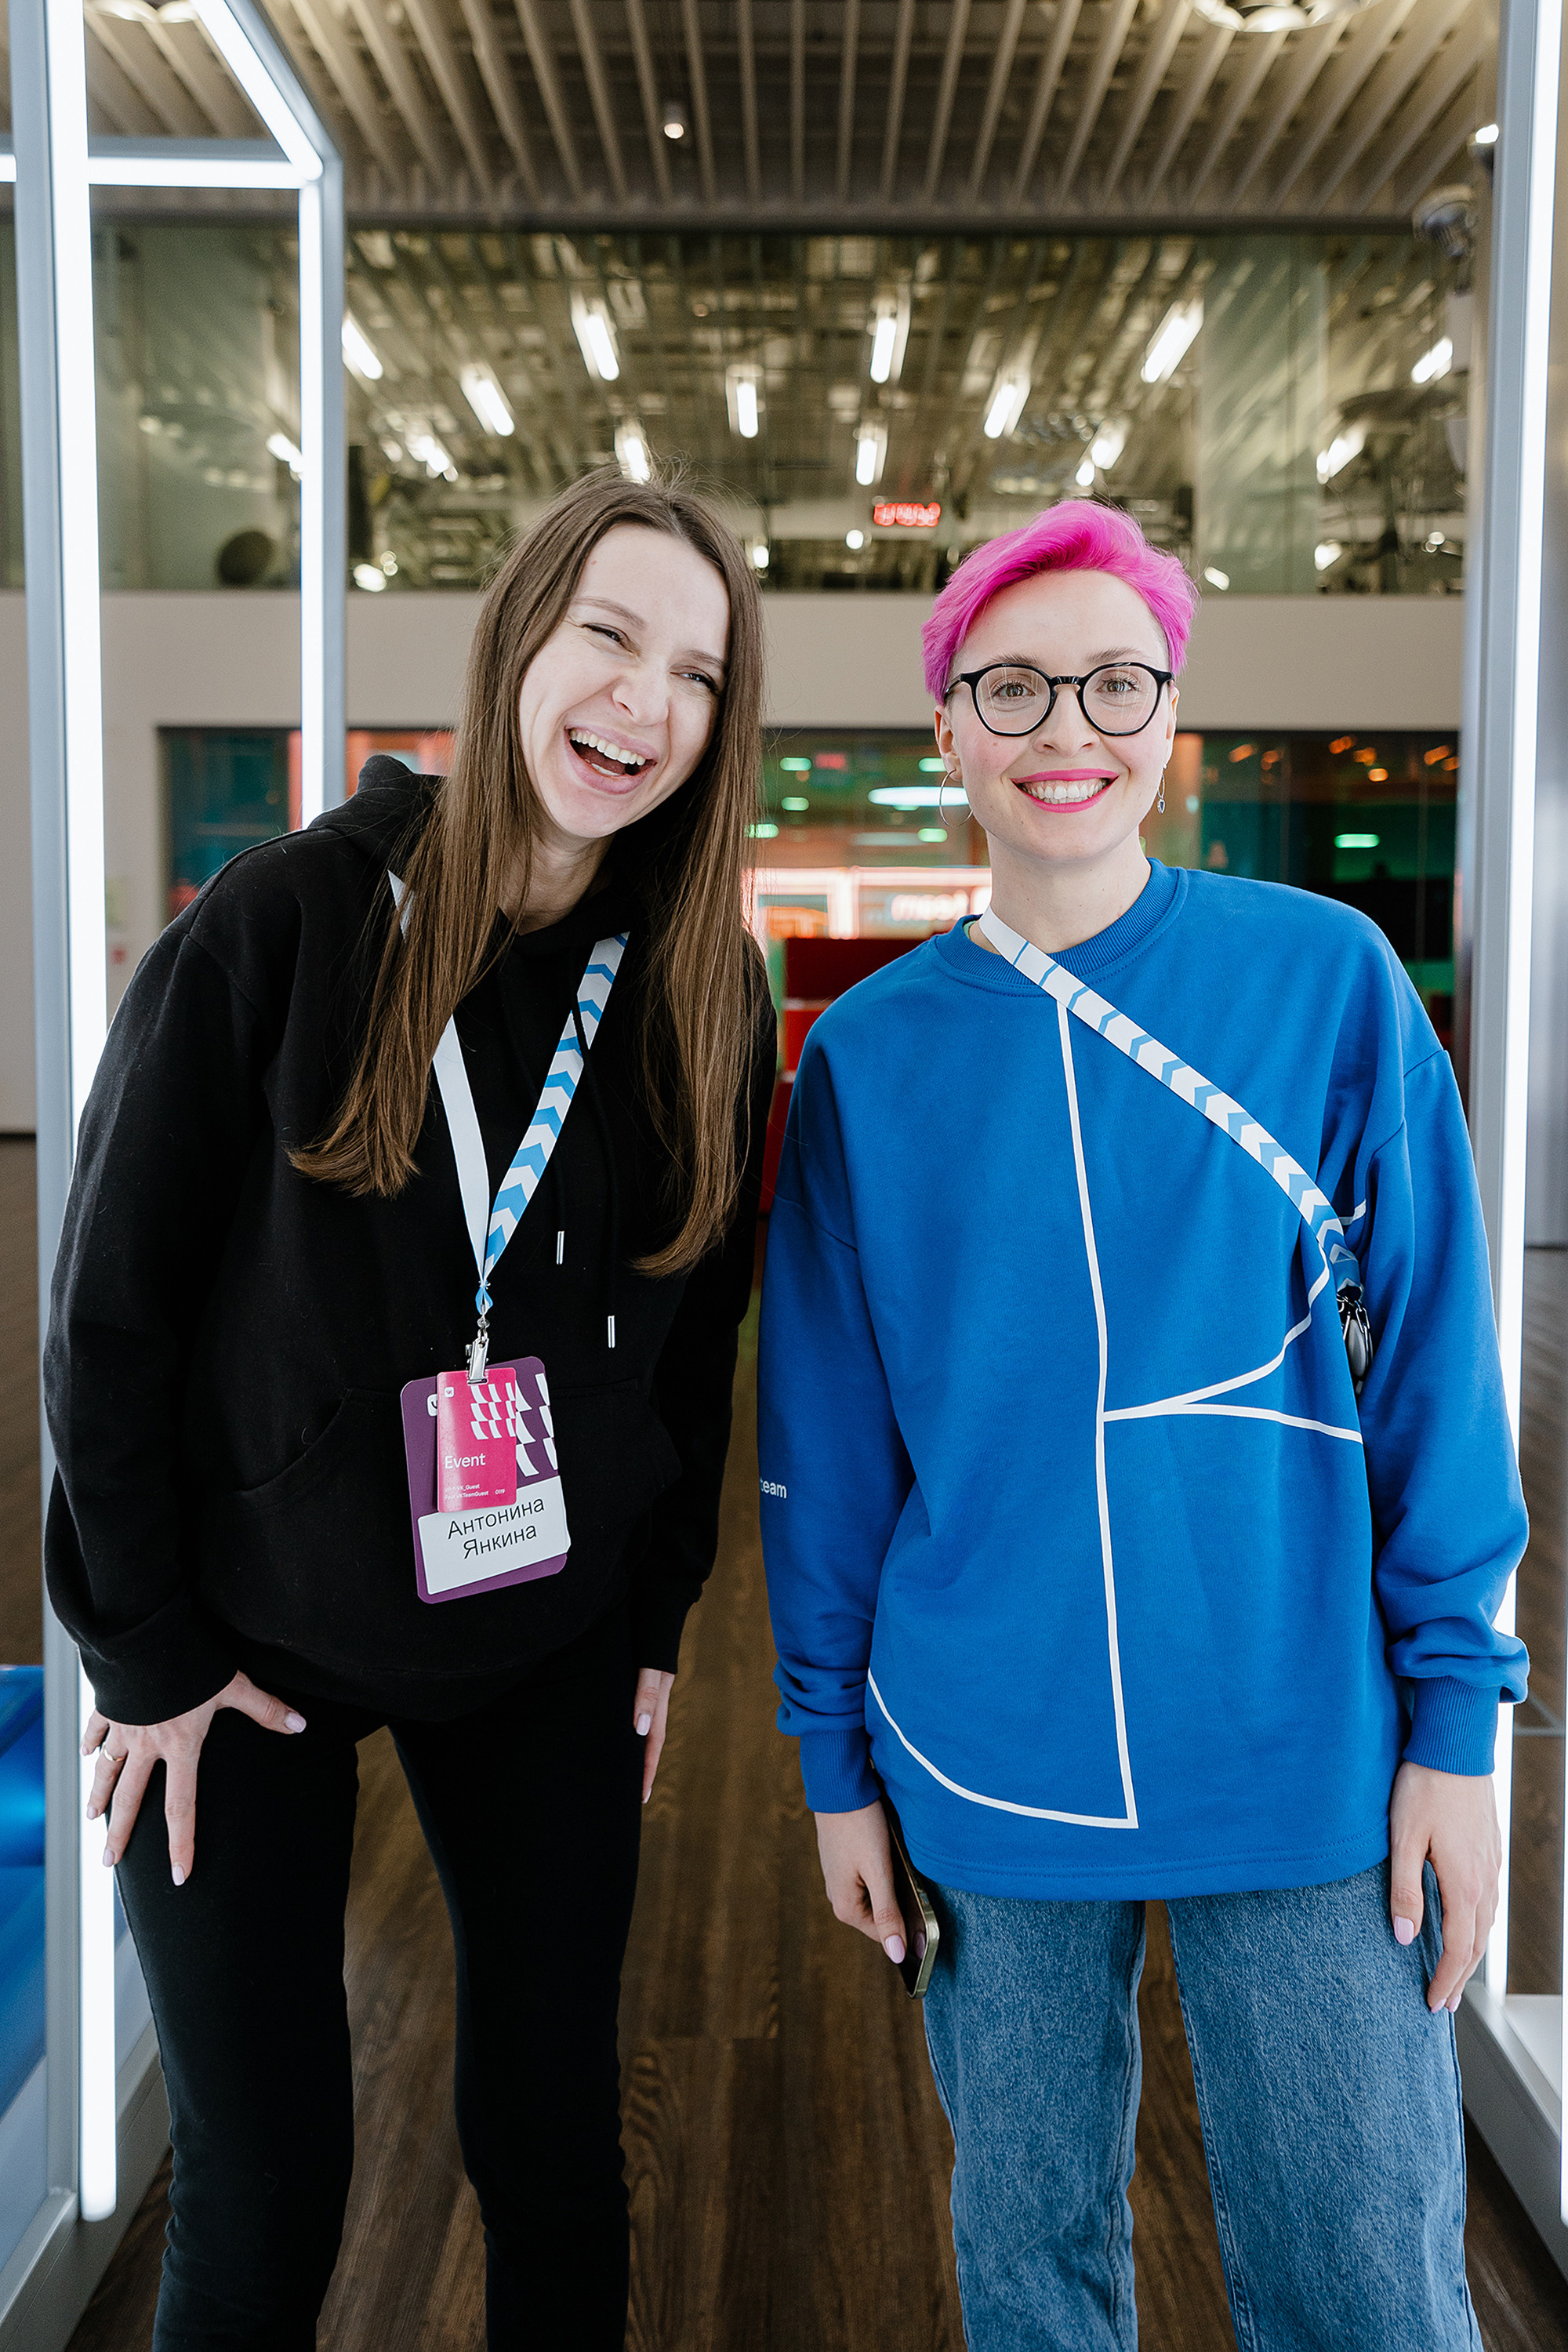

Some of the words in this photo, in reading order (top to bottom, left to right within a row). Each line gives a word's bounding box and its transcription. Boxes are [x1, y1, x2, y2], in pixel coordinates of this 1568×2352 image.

[445, 1453, 486, 1469] Event
[448, 1498, 545, 1540] Антонина
[463, 1525, 537, 1559] Янкина
